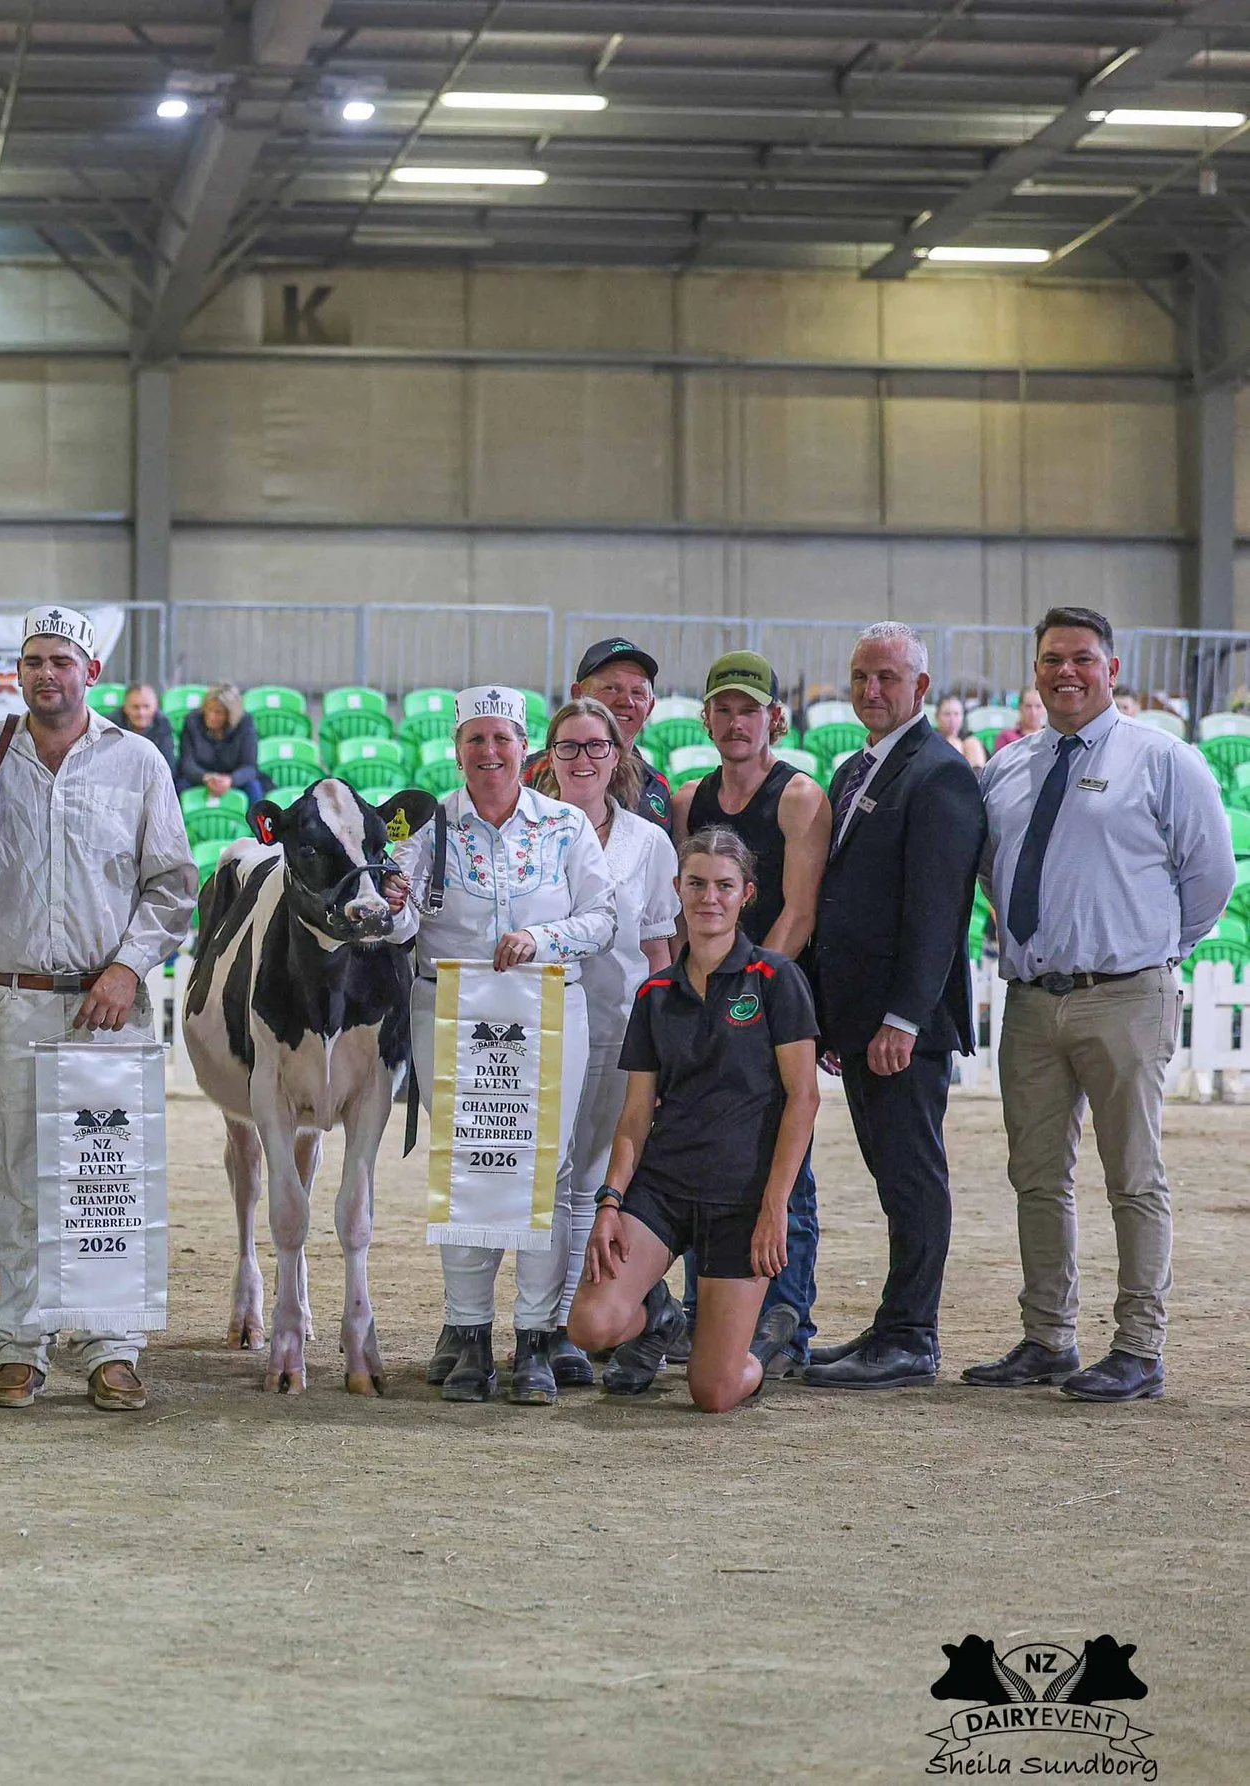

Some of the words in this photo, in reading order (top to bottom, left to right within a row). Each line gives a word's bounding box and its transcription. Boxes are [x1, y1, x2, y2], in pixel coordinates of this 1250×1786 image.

[35, 619, 75, 637] SEMEX
[474, 701, 514, 717] SEMEX
[488, 1053, 508, 1064] NZ
[476, 1065, 520, 1077] DAIRY
[473, 1078, 521, 1090] EVENT
[462, 1101, 529, 1114] CHAMPION
[471, 1115, 517, 1127] JUNIOR
[455, 1127, 533, 1141] INTERBREED
[92, 1139, 112, 1150] NZ
[80, 1152, 125, 1163] DAIRY
[469, 1152, 518, 1167] 2026
[79, 1164, 127, 1175] EVENT
[76, 1183, 130, 1194] RESERVE
[69, 1195, 137, 1205] CHAMPION
[81, 1207, 126, 1216] JUNIOR
[65, 1218, 142, 1229] INTERBREED
[79, 1237, 127, 1252] 2026
